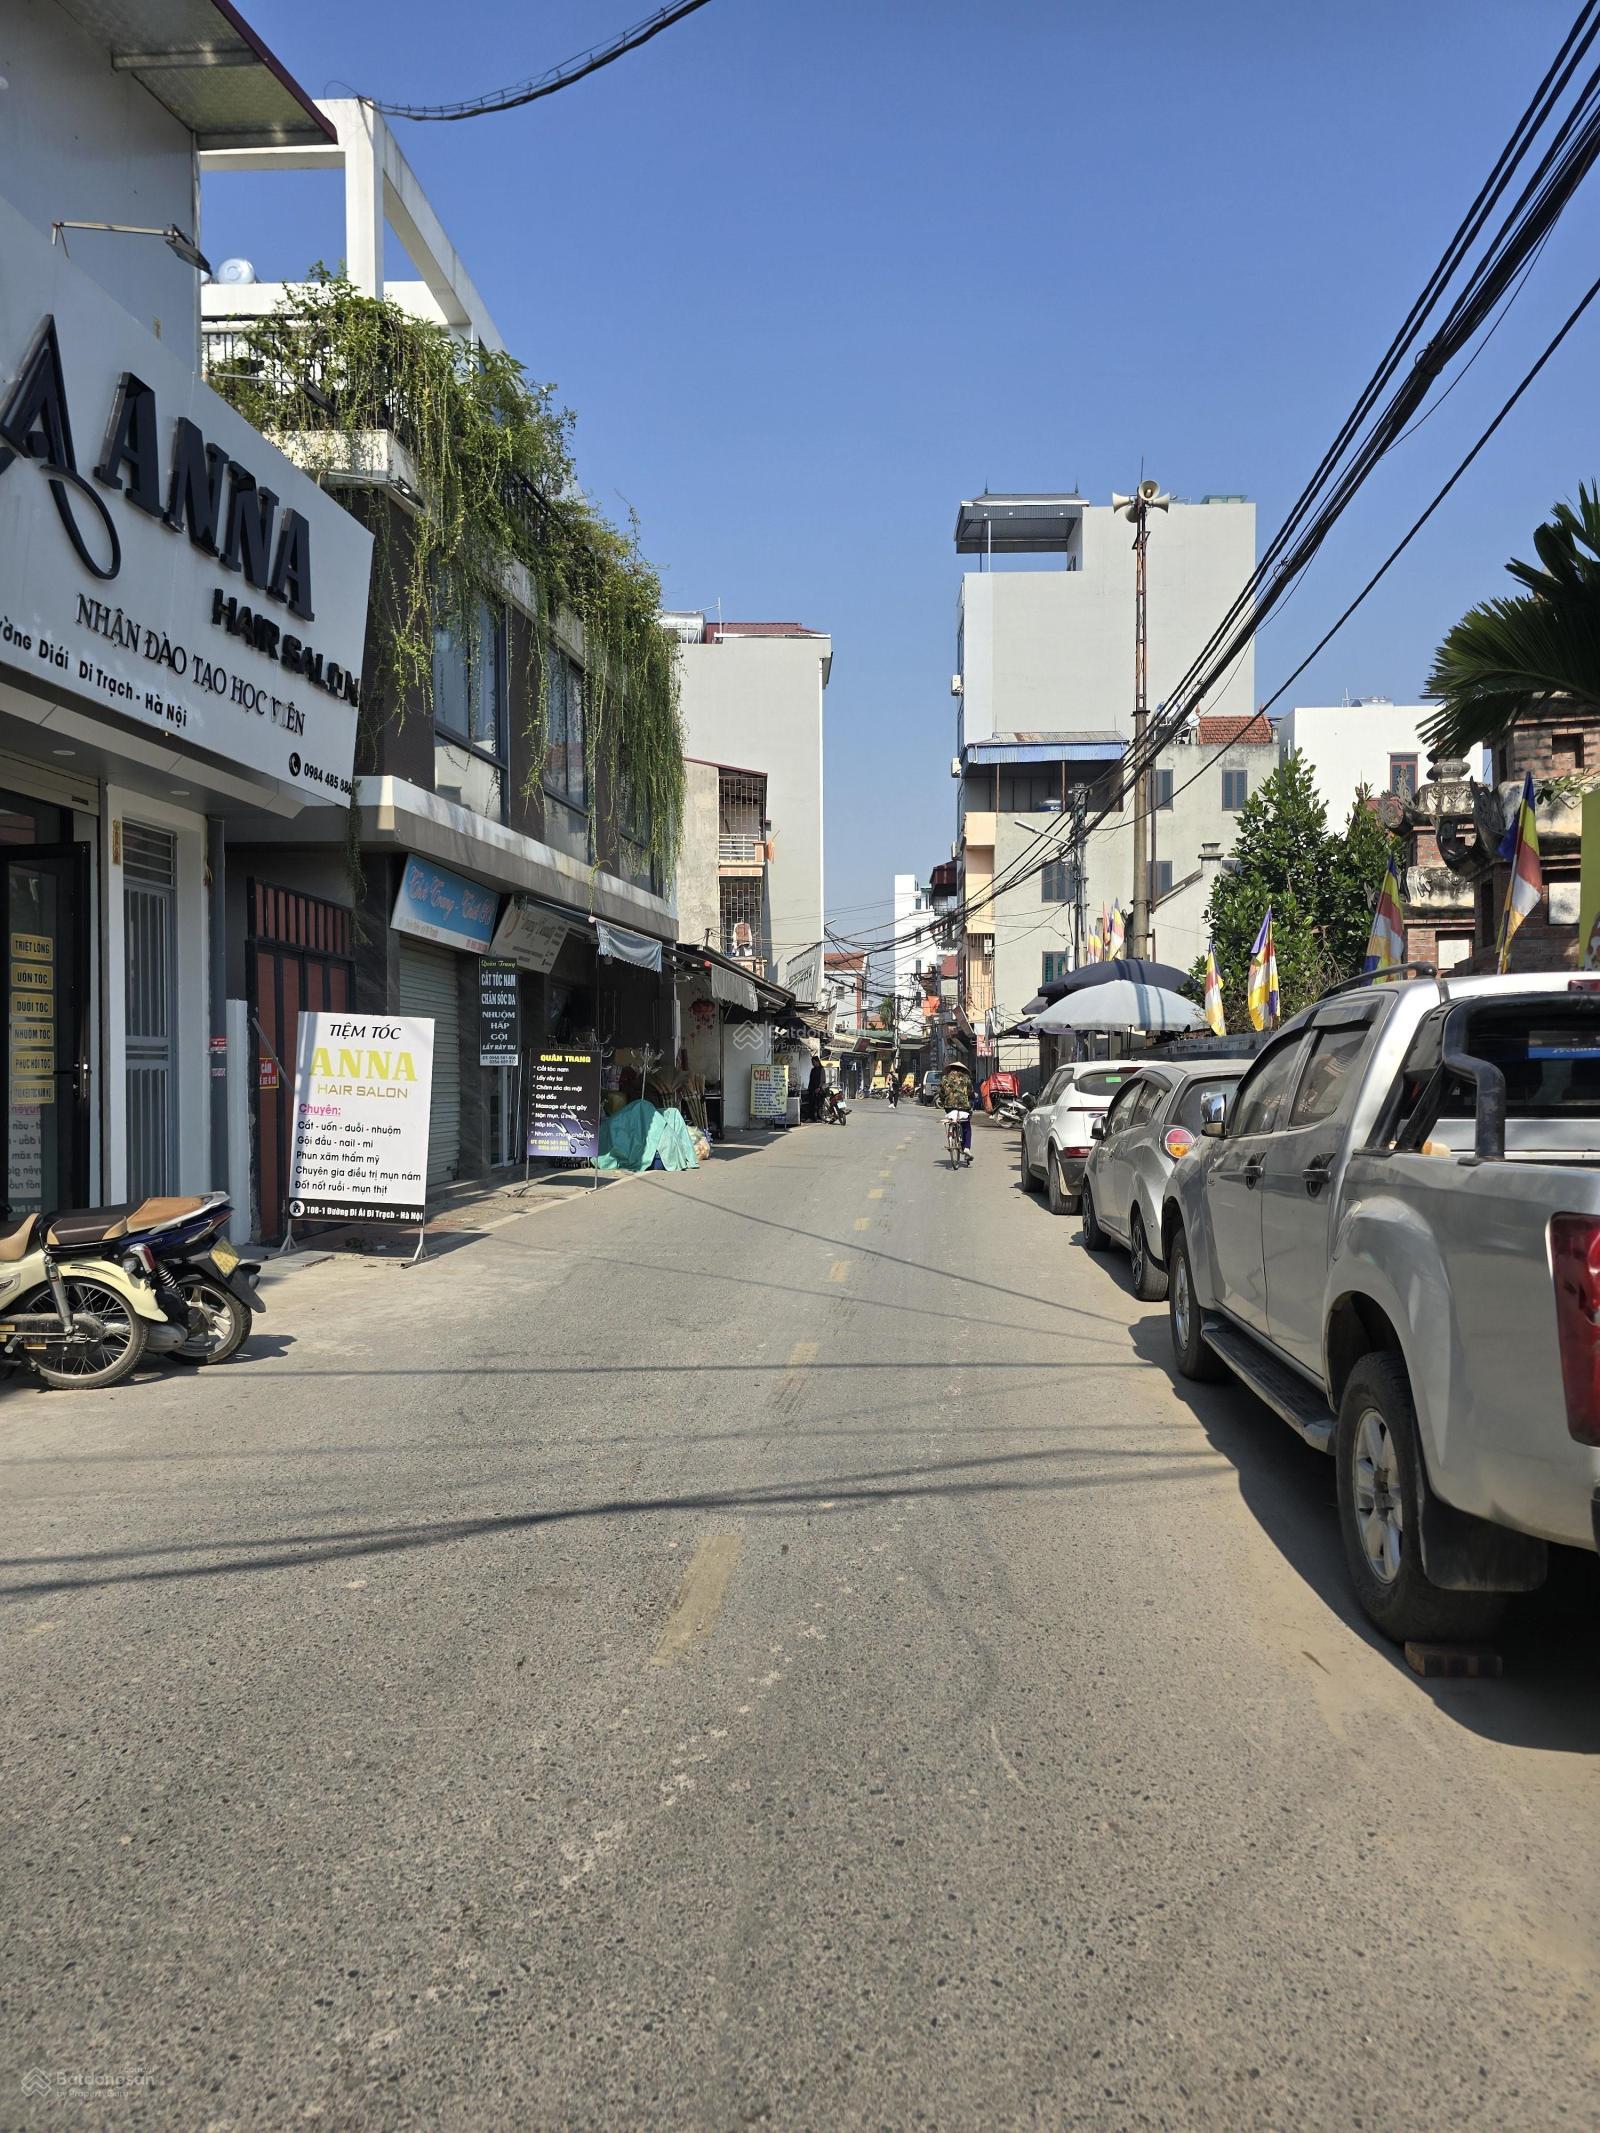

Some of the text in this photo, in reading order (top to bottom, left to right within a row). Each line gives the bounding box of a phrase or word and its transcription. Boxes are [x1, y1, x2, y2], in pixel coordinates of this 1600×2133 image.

[93, 371, 315, 622] ANNA
[75, 592, 141, 652] NHẬN
[143, 629, 187, 676] ĐÀO
[192, 654, 227, 695] TẠO
[230, 675, 267, 715] HỌC
[212, 588, 361, 707] HAIR SALON
[79, 660, 93, 682] Di
[96, 668, 133, 700] Trạch
[145, 692, 163, 715] Hà
[166, 703, 187, 728] Nội
[304, 763, 323, 783] 0984
[325, 773, 339, 790] 485
[481, 970, 516, 986] CẮT TÓC NAM
[497, 991, 508, 1005] SÓC
[508, 994, 516, 1005] DA
[482, 1010, 516, 1020] NHUỘM
[330, 1022, 401, 1040] TIỆM TÓC
[490, 1020, 510, 1029] HẤP
[490, 1032, 508, 1042] GỘI
[308, 1047, 418, 1082] ANNA
[540, 1054, 591, 1063] QUÂN TRANG
[317, 1084, 408, 1098] HAIR SALON
[299, 1103, 341, 1116] Chuyên:
[297, 1119, 314, 1130] Cắt
[321, 1121, 337, 1131] uốn
[371, 1126, 401, 1137] nhuộm
[297, 1136, 312, 1147] Gội
[314, 1134, 332, 1146] đầu
[339, 1138, 355, 1147] nail
[363, 1139, 374, 1148] mi
[296, 1150, 317, 1160] Phun
[320, 1151, 339, 1161] xăm
[295, 1165, 421, 1182] Chuyên gia điều trị mụn nám
[295, 1180, 310, 1190] Đốt
[312, 1180, 326, 1191] nốt
[352, 1185, 371, 1196] mụn
[373, 1184, 388, 1197] thịt
[375, 1208, 395, 1219] Trạch
[400, 1209, 410, 1219] Hà
[410, 1210, 423, 1220] Nội
